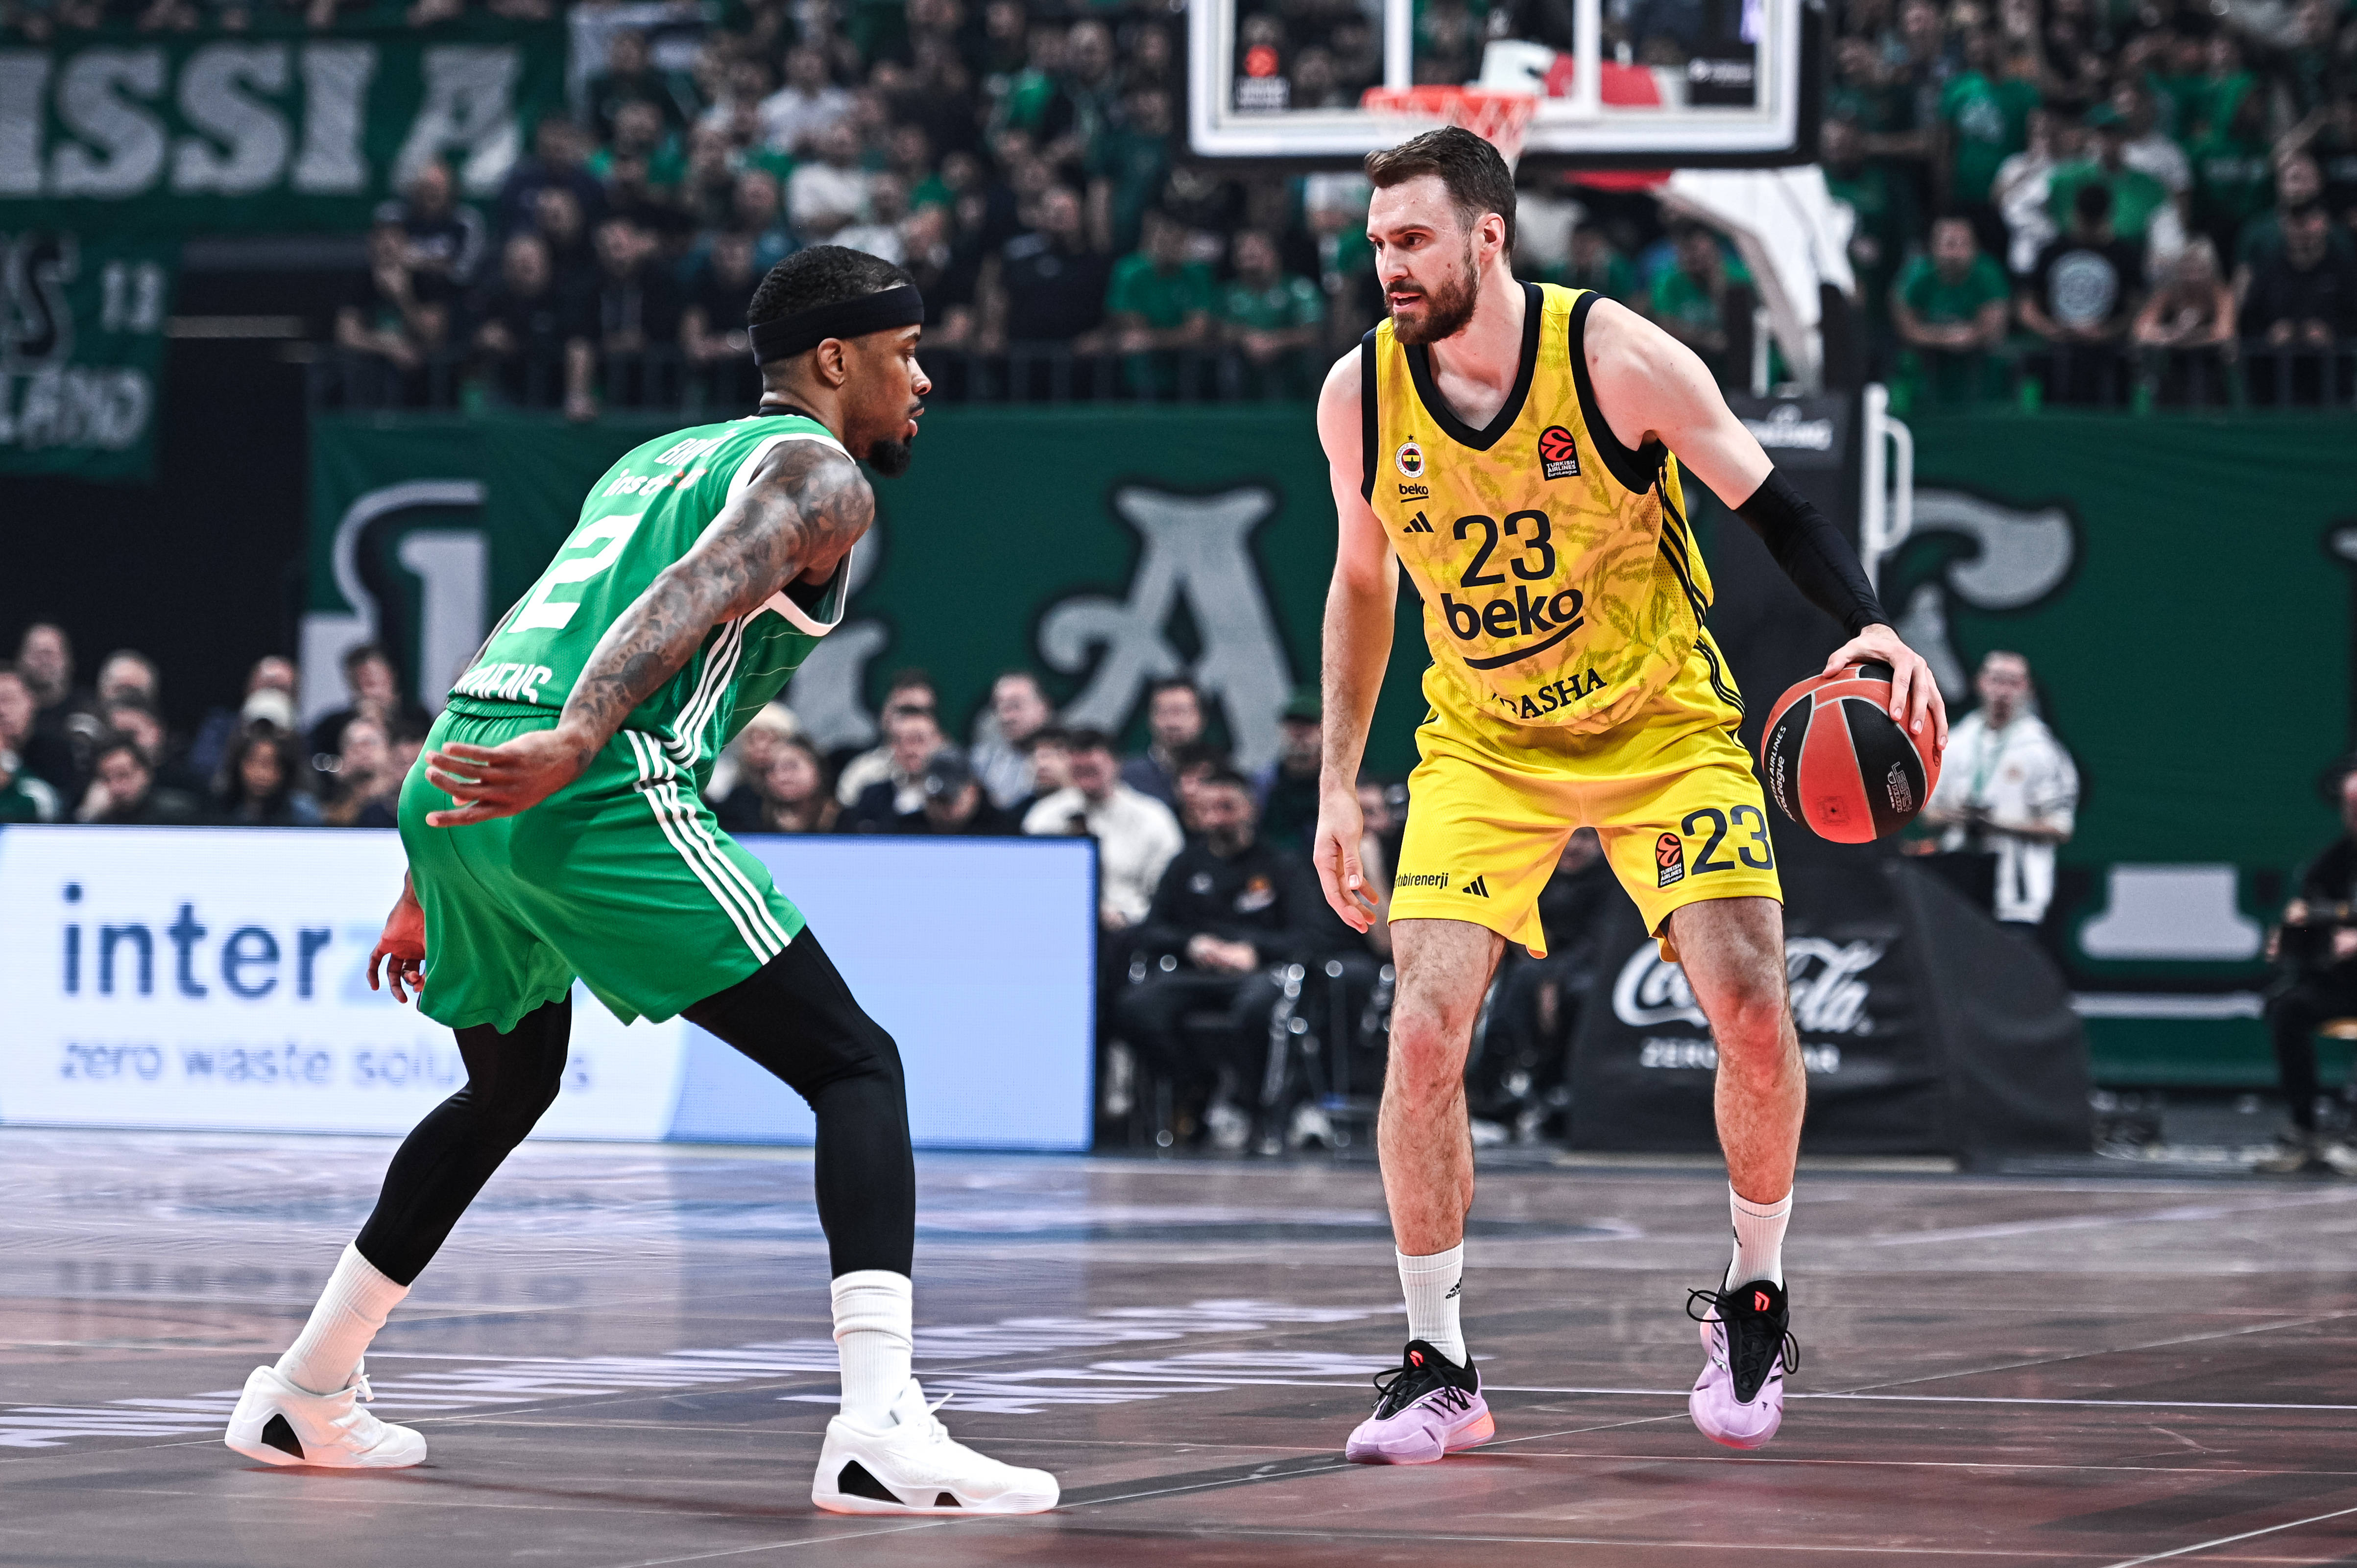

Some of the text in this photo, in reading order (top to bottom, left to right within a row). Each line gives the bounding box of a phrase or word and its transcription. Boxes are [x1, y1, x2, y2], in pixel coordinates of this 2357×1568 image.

[1398, 483, 1429, 495] beko
[1547, 465, 1576, 473] AIRLINES
[509, 512, 644, 633] 2
[1453, 509, 1556, 588] 23
[1441, 585, 1584, 641] beko
[1769, 725, 1787, 776] AIRLINES
[1681, 805, 1774, 876] 23
[1660, 862, 1682, 876] TURKISH
[1660, 868, 1682, 881] AIRLINES
[65, 1033, 591, 1093] zero waste solus
